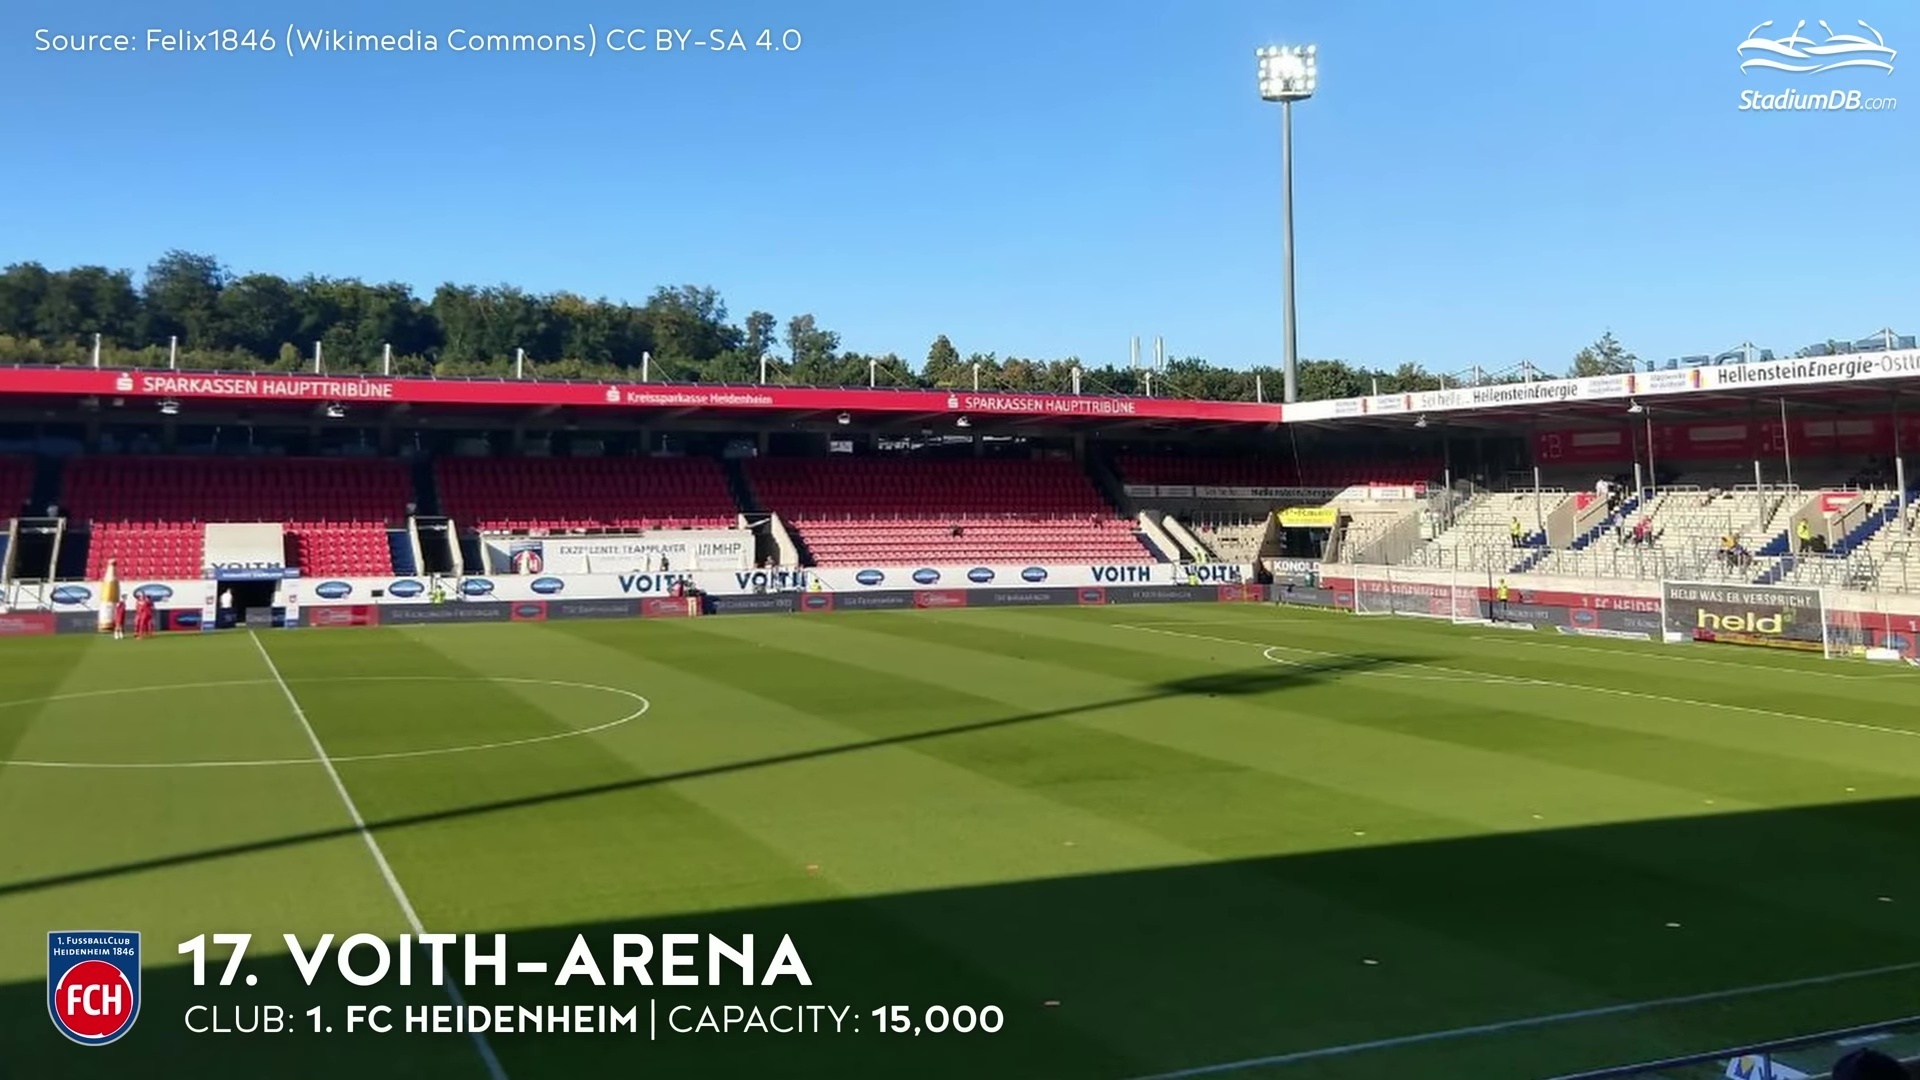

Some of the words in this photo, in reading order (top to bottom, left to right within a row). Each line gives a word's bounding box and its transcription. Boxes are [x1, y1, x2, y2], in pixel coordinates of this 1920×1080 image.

[142, 377, 258, 395] SPARKASSEN
[262, 379, 393, 398] HAUPTTRIBÜNE
[1472, 383, 1578, 403] HellensteinEnergie
[627, 391, 708, 406] Kreissparkasse
[710, 394, 773, 405] Heidenheim
[965, 396, 1043, 411] SPARKASSEN
[1046, 400, 1135, 414] HAUPTTRIBÜNE
[1091, 566, 1150, 582] VOITH
[1184, 565, 1242, 582] VOITH
[1273, 560, 1321, 572] KONOLD
[1670, 589, 1697, 600] HELD
[1700, 591, 1723, 602] WAS
[1698, 608, 1782, 633] held
